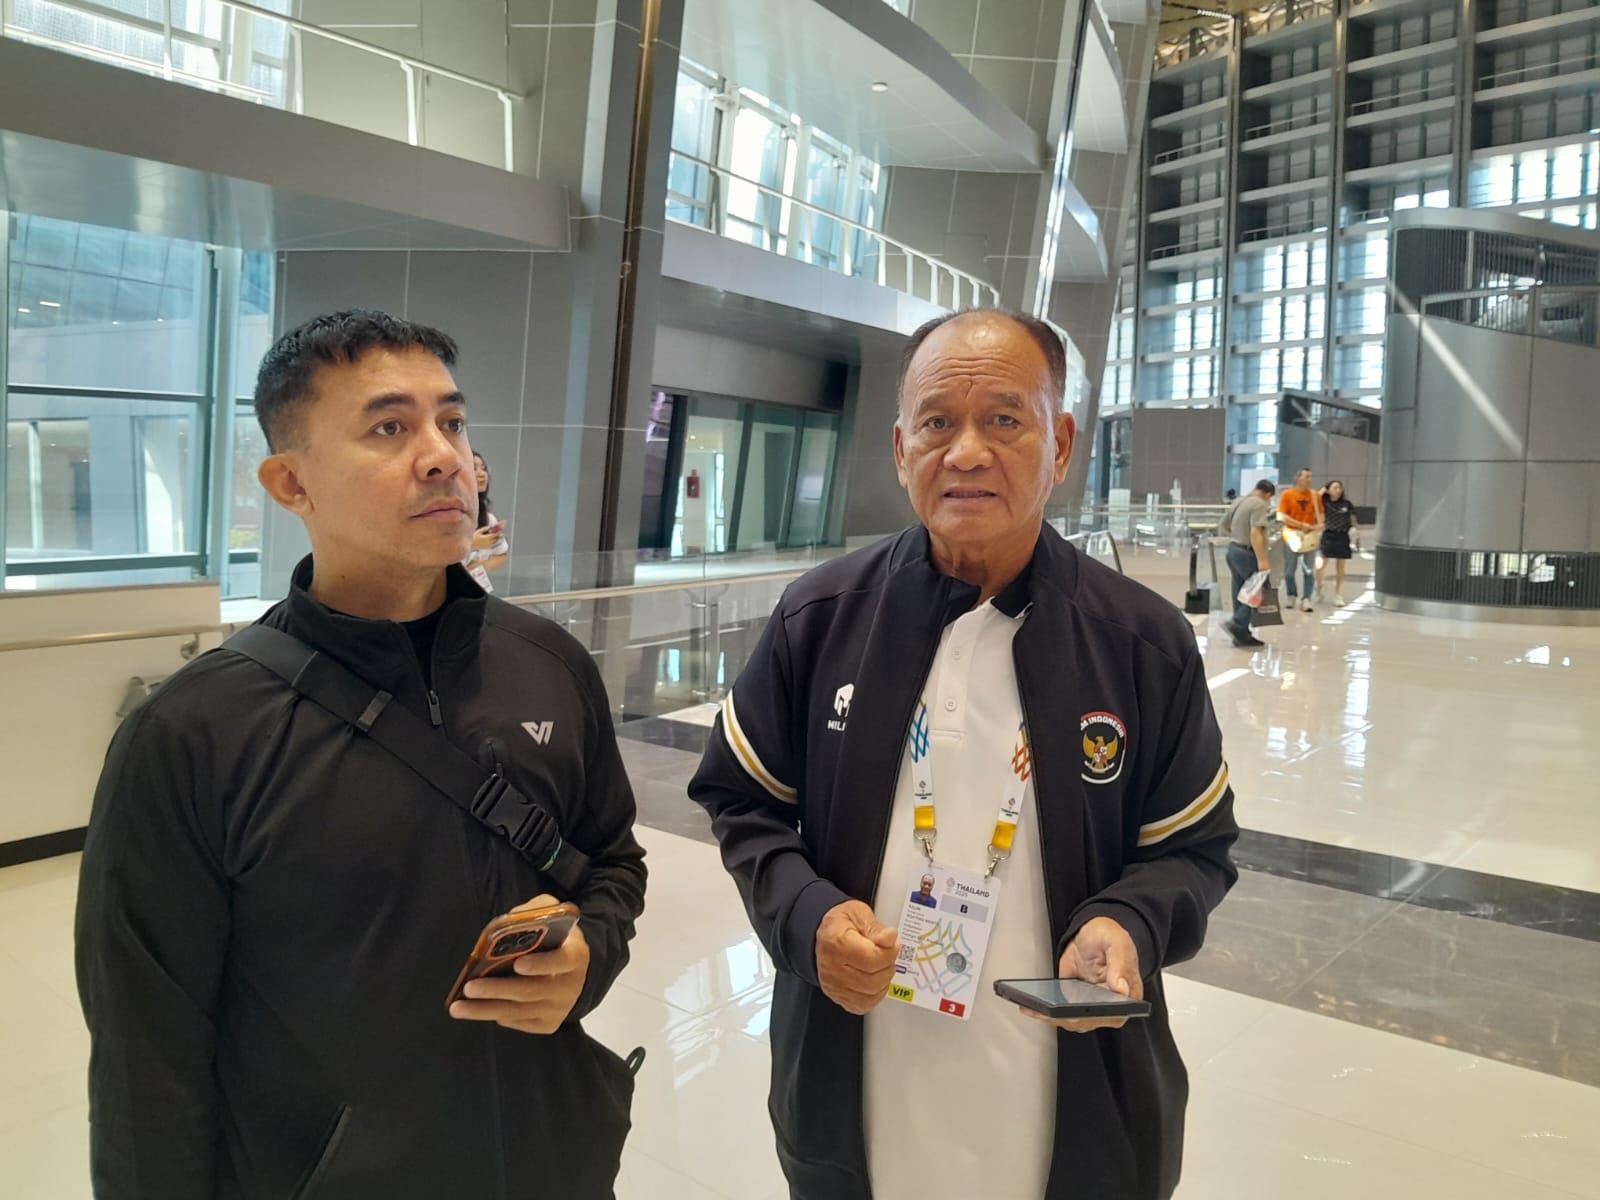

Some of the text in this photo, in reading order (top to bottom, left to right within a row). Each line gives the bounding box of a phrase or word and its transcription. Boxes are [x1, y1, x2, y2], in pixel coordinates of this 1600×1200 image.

[956, 882, 990, 899] THAILAND
[960, 904, 968, 914] B
[892, 986, 911, 998] VIP
[948, 1003, 956, 1013] 3
